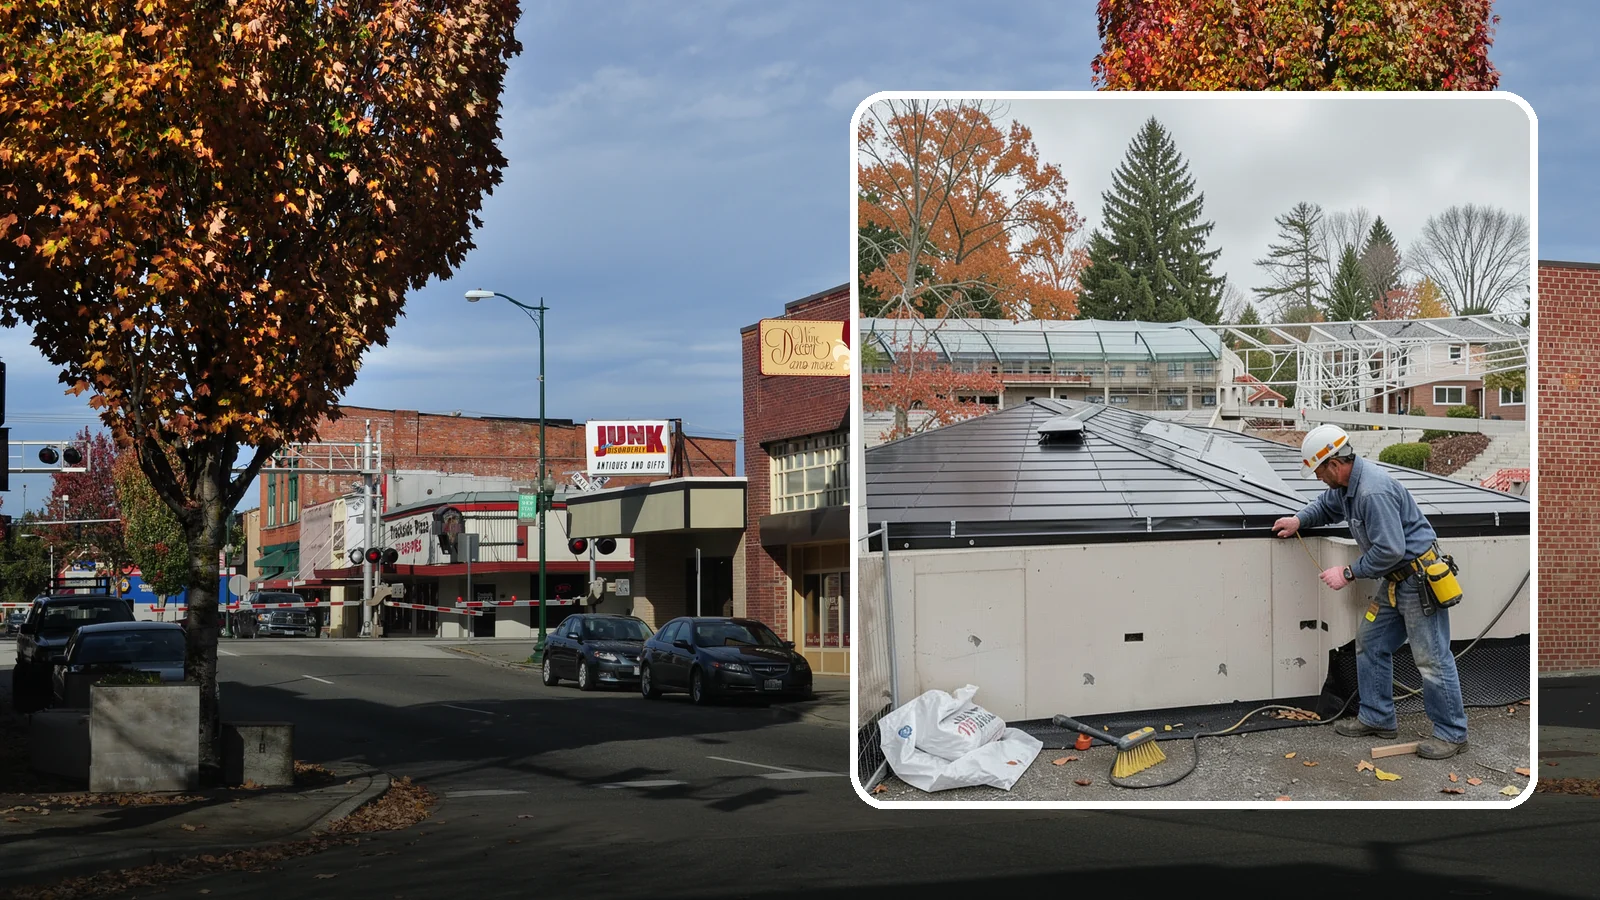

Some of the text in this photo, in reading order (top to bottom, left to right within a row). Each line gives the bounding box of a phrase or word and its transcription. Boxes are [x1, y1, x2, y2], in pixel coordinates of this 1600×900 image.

[595, 425, 665, 457] JUNK
[607, 446, 645, 454] DISORDERLY
[597, 460, 665, 470] ANTIQUES AND GIFTS
[390, 519, 429, 539] Trackside Pizza
